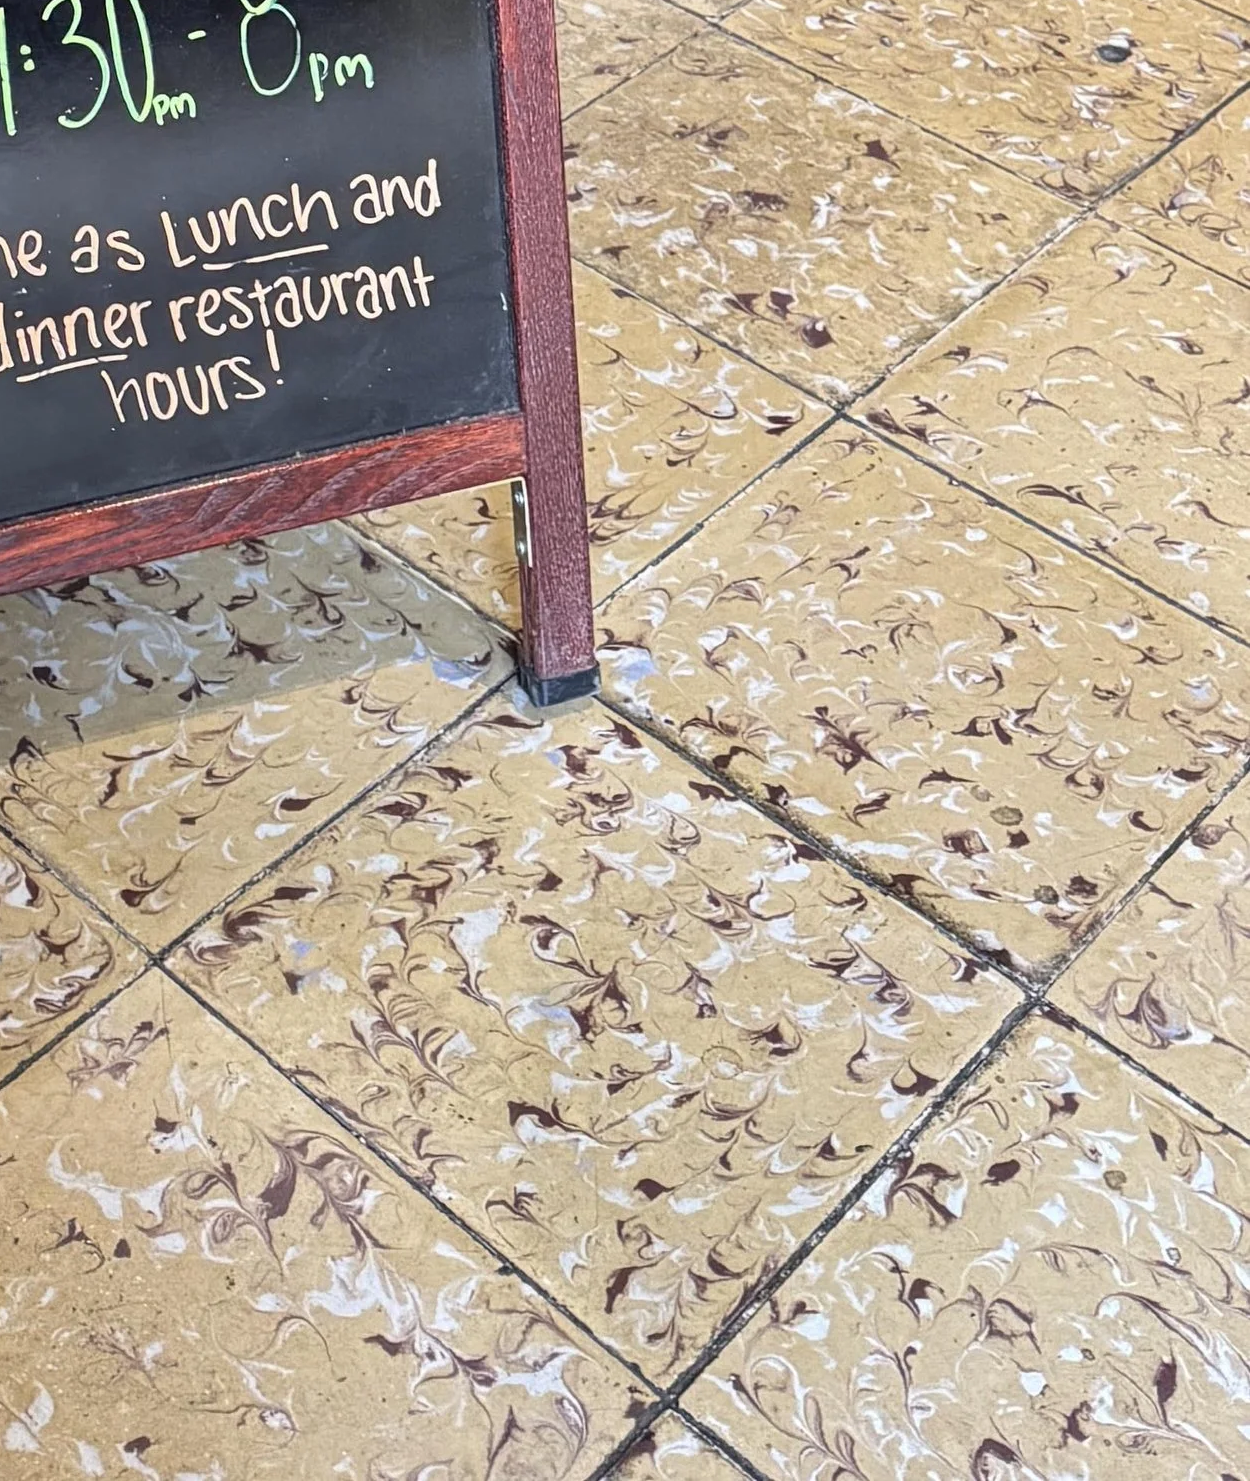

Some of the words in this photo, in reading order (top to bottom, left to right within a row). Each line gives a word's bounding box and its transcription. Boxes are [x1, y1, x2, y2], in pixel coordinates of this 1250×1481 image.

[71, 222, 147, 275] as
[350, 158, 444, 225] and
[166, 254, 437, 337] restaurant
[100, 327, 286, 427] hours!
